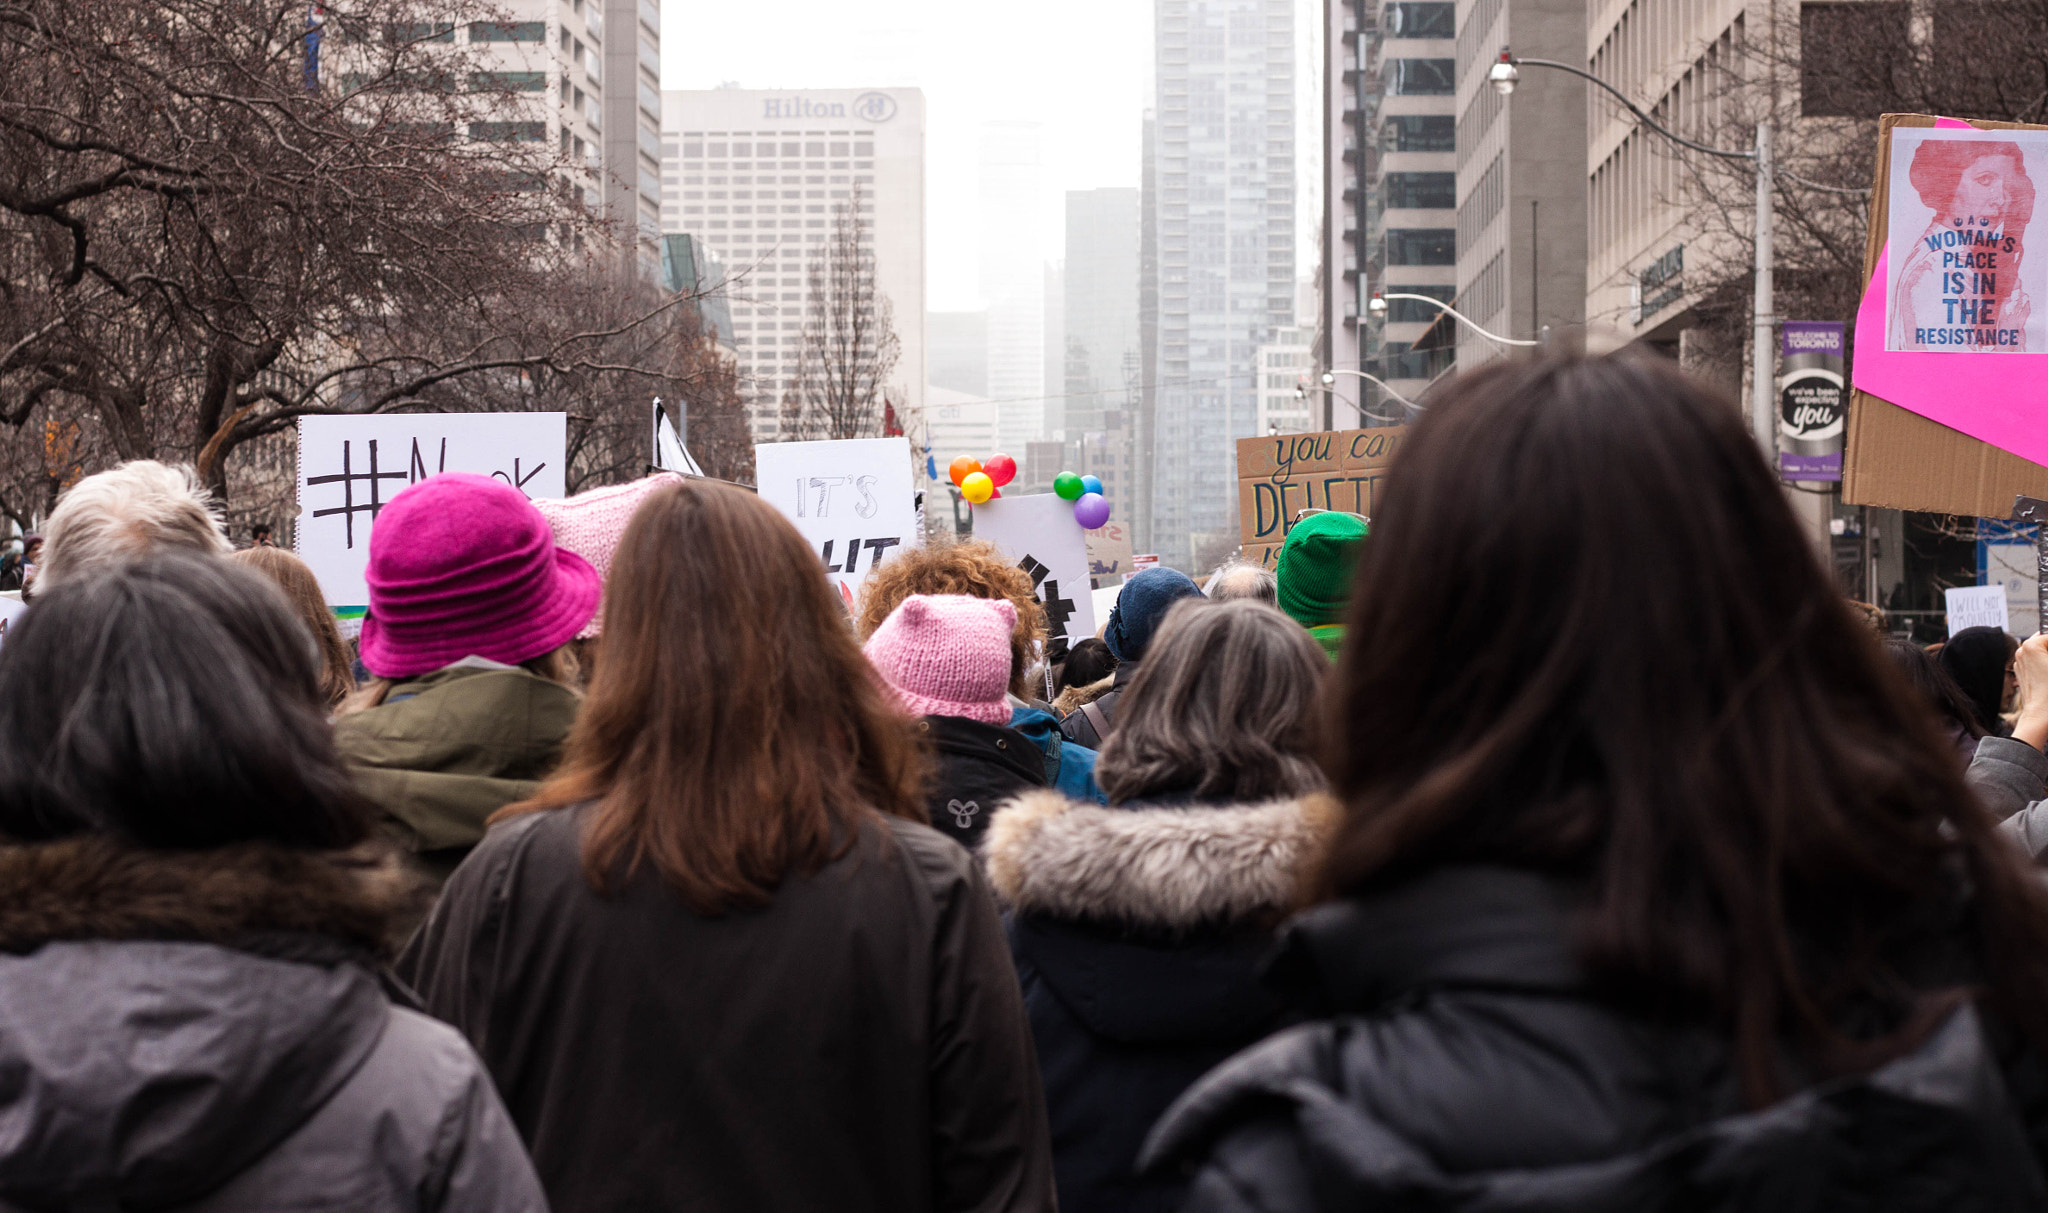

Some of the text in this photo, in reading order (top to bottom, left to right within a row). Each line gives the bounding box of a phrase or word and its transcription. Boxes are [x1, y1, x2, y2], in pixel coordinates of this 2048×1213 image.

[763, 96, 846, 118] Hilton
[1967, 215, 1975, 225] A
[1924, 229, 2016, 253] WOMAN'S
[1943, 252, 1997, 269] PLACE
[1943, 271, 1996, 295] IS IN
[1942, 298, 1995, 325] THE
[1788, 339, 1840, 349] TORONTO
[1915, 328, 2019, 346] RESISTANCE
[1788, 387, 1840, 396] we've been
[1795, 396, 1840, 406] expecting
[1793, 405, 1833, 434] you
[1271, 436, 1333, 485] you
[796, 474, 878, 519] IT'S
[821, 537, 901, 574] LIT
[1956, 596, 1980, 613] WILL
